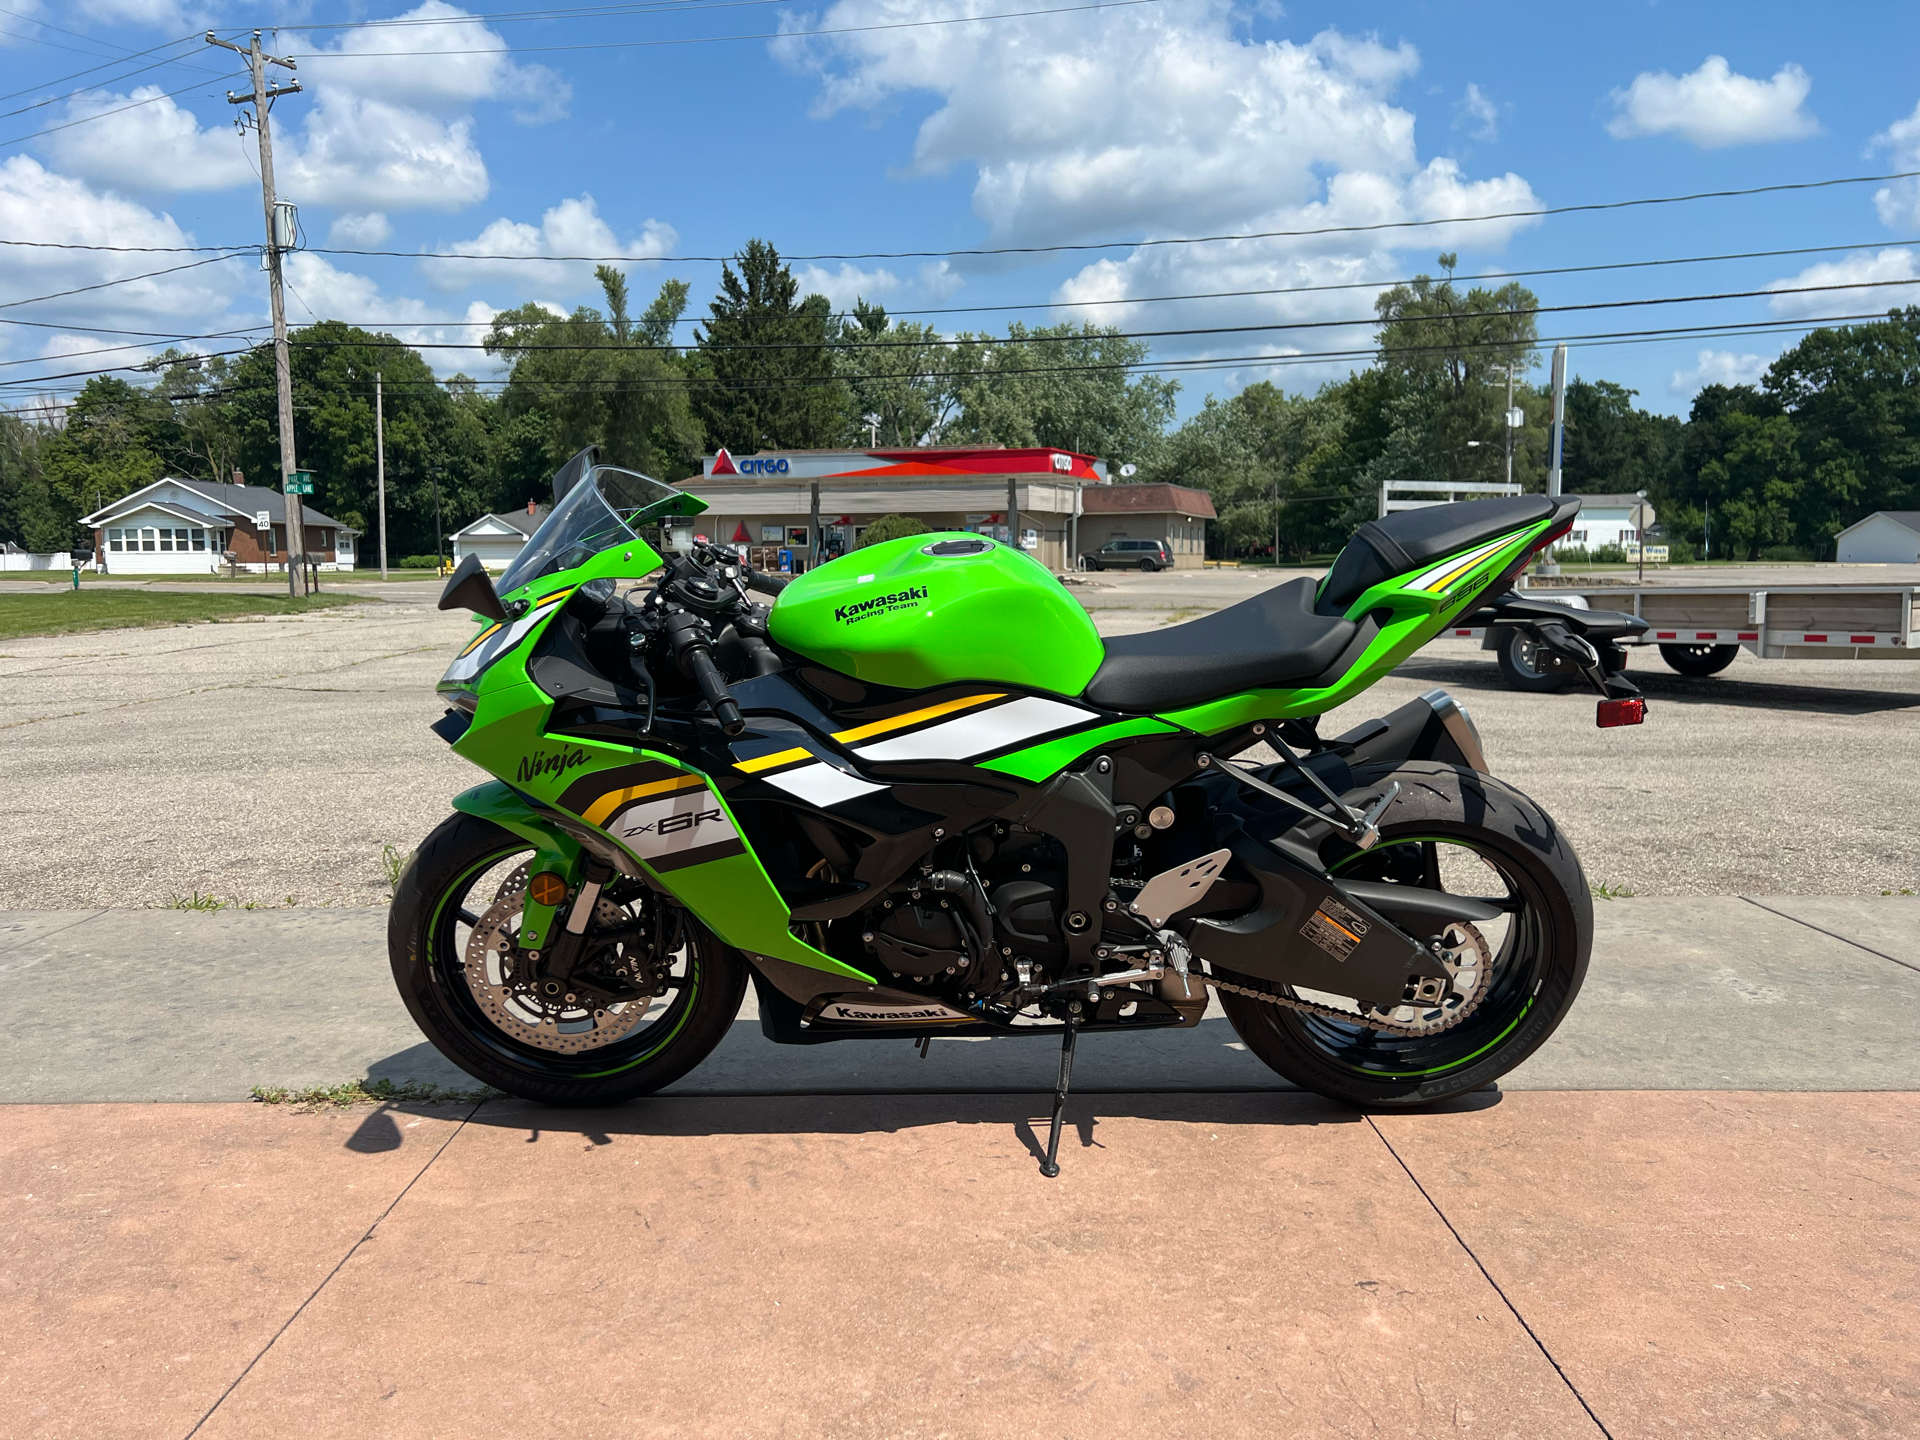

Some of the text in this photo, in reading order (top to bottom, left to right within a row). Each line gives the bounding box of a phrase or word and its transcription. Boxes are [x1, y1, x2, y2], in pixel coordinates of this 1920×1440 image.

[740, 459, 789, 474] CITGO
[286, 484, 312, 492] APPLE LANE
[1646, 546, 1666, 554] Wash
[834, 585, 928, 622] Kawasaki
[1439, 572, 1490, 614] 636
[846, 601, 918, 626] Racing Team
[516, 744, 592, 784] Ninja
[622, 808, 725, 839] ZX-6R
[835, 1006, 948, 1019] Kawasaki
[1499, 1019, 1544, 1064] DIABLO
[1450, 1063, 1498, 1090] ROSSO
